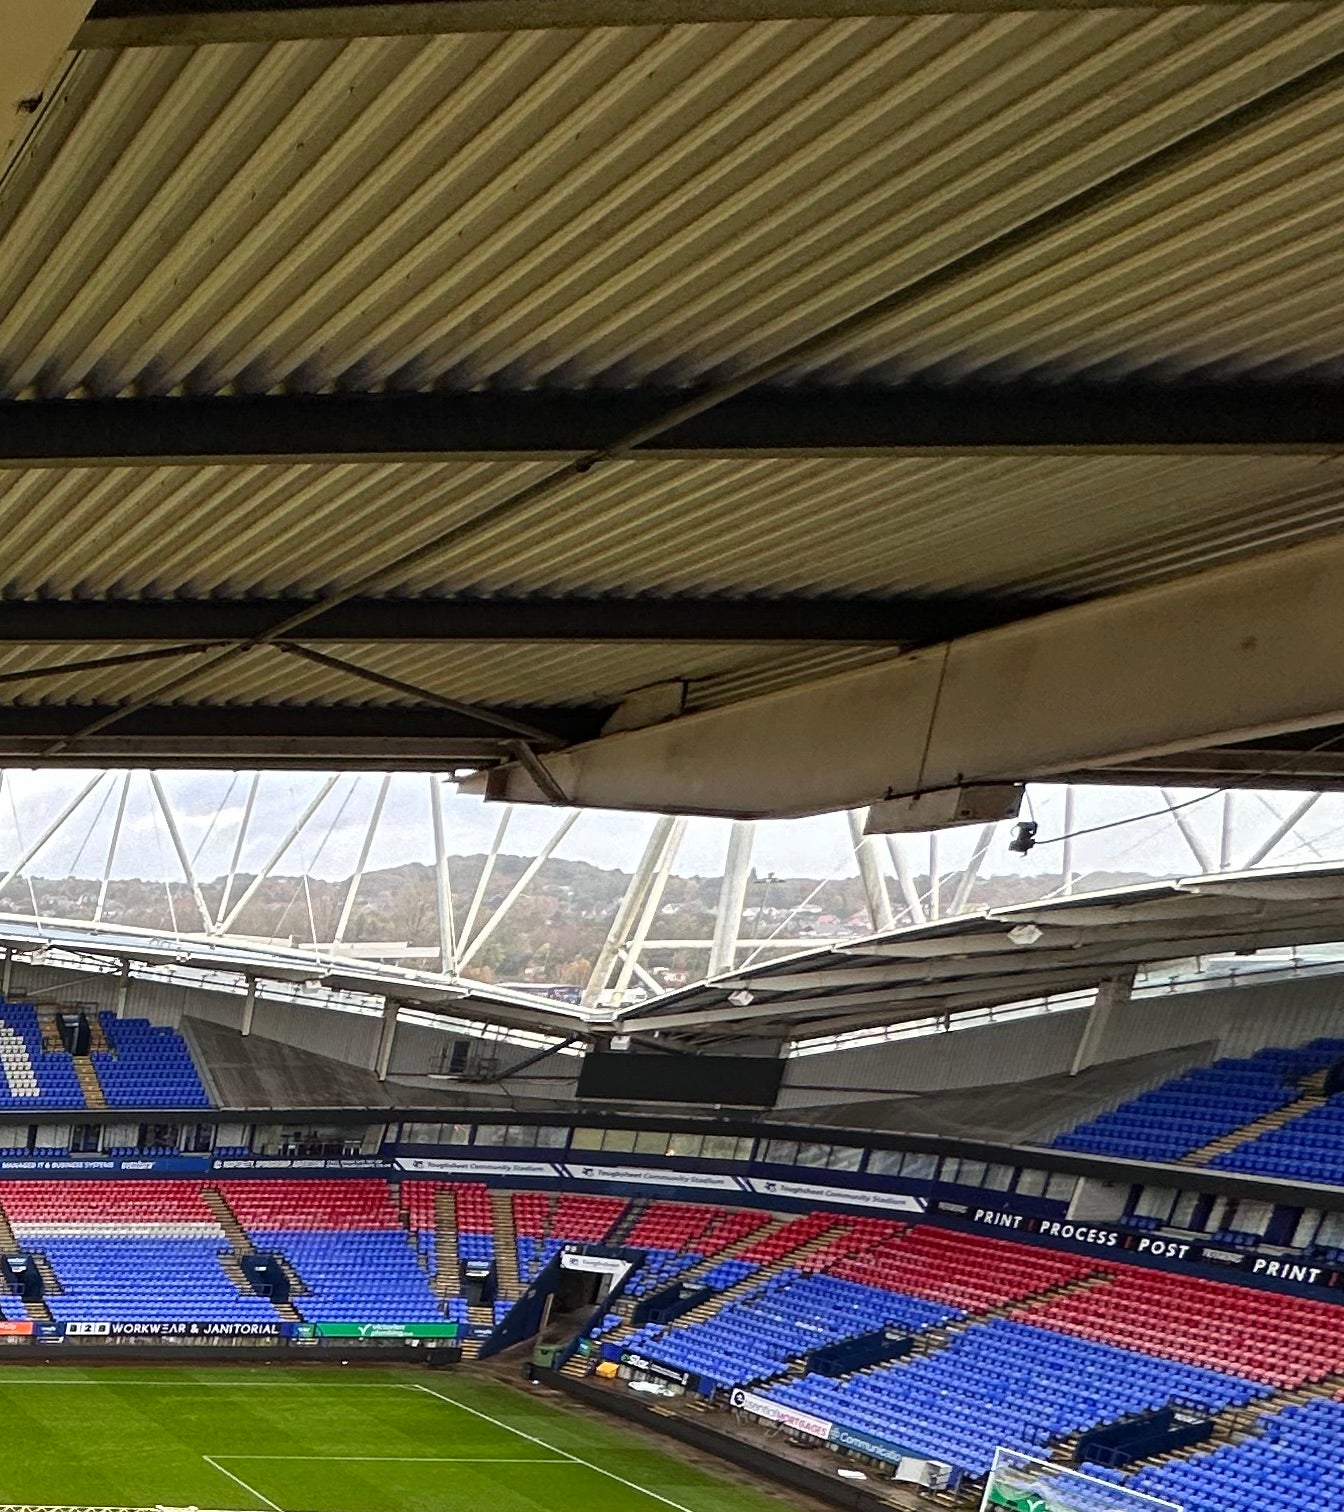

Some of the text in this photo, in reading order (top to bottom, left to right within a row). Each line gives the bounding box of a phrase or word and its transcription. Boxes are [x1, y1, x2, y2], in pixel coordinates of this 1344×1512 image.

[825, 1189, 871, 1203] Community
[872, 1195, 907, 1206] Stadium
[973, 1209, 1023, 1229] PRINT
[1039, 1220, 1118, 1247] PROCESS
[1138, 1238, 1190, 1259] POST
[1253, 1258, 1322, 1284] PRINT
[112, 1322, 280, 1335] WORKWEAR & JANITORIAL
